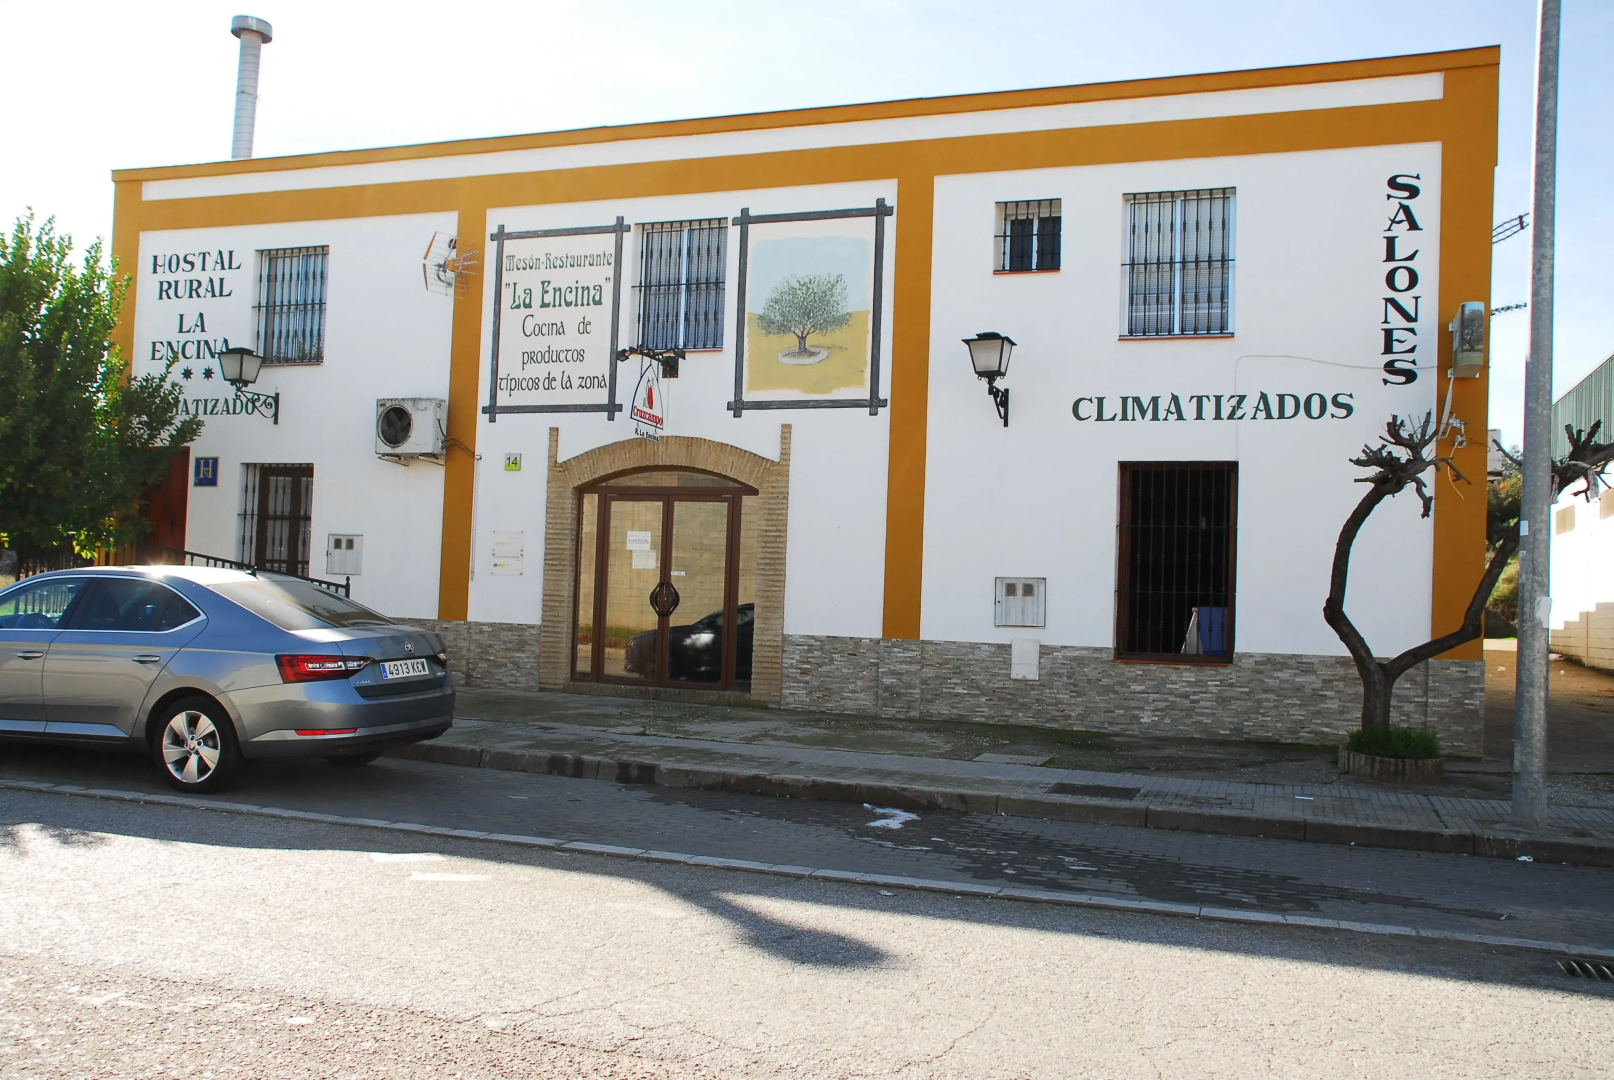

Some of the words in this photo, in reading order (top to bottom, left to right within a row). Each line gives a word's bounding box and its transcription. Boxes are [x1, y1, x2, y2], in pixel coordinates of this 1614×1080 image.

[151, 249, 242, 274] HOSTAL
[157, 276, 233, 300] RURAL
[1381, 173, 1423, 386] SALONES
[177, 311, 207, 333] LA
[522, 314, 565, 337] Cocina
[577, 316, 592, 335] de
[150, 337, 230, 360] ENCINA
[521, 344, 585, 371] productos
[499, 373, 540, 397] típicos
[542, 370, 557, 391] de
[560, 371, 573, 390] la
[577, 373, 608, 390] zona
[633, 405, 663, 426] Cruzcampo
[1071, 391, 1355, 422] CLIMATIZADOS
[506, 456, 518, 467] 14
[388, 662, 410, 675] 4913
